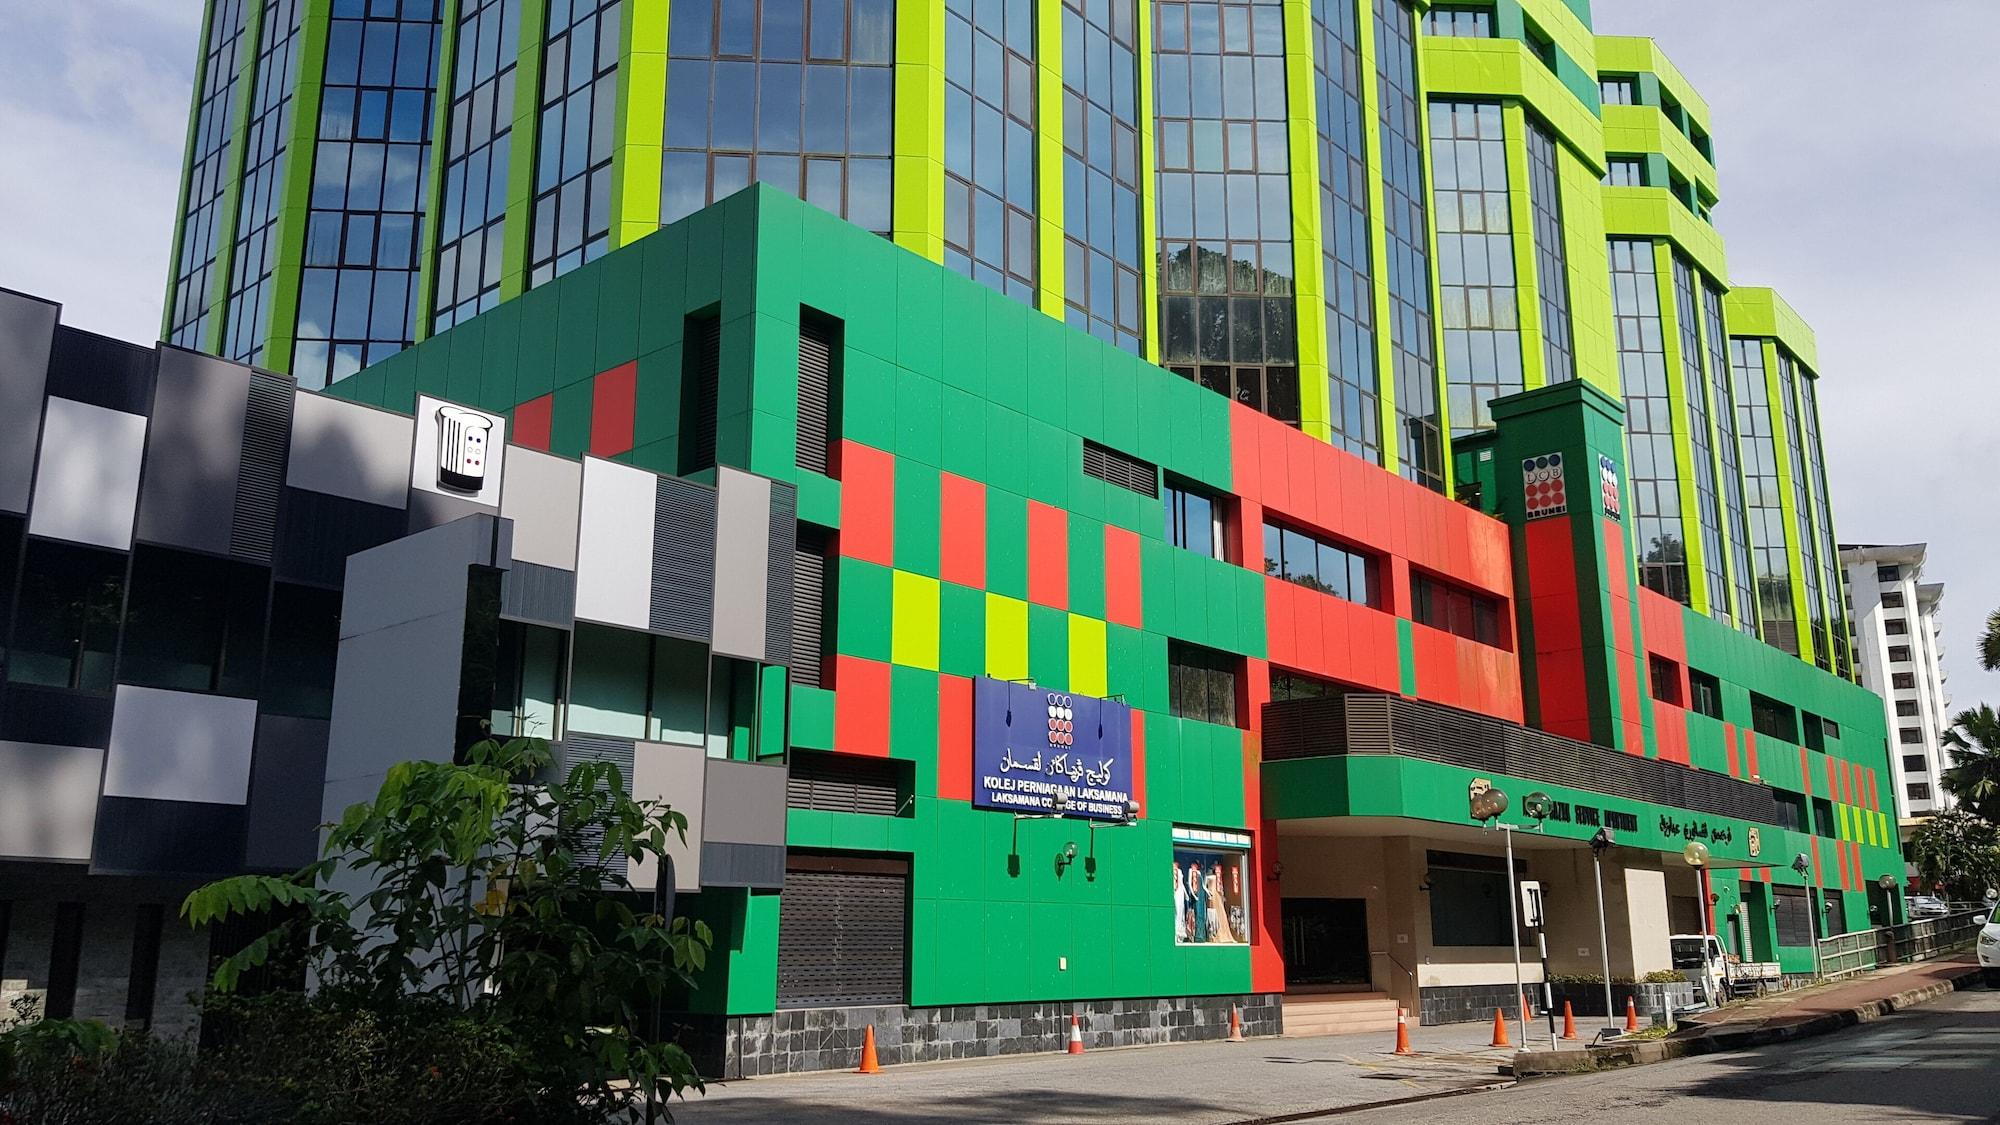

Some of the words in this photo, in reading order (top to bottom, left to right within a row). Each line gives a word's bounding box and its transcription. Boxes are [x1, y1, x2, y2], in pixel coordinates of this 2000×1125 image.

[1527, 506, 1566, 519] BRUNEI
[983, 776, 1016, 791] KOLEJ
[1017, 780, 1076, 798] PERNIAGAAN
[1077, 787, 1128, 803] LAKSAMANA
[991, 791, 1041, 807] LAKSAMANA
[1041, 797, 1076, 810] COGE
[1076, 803, 1087, 811] OF
[1088, 803, 1123, 815] BUSINESS
